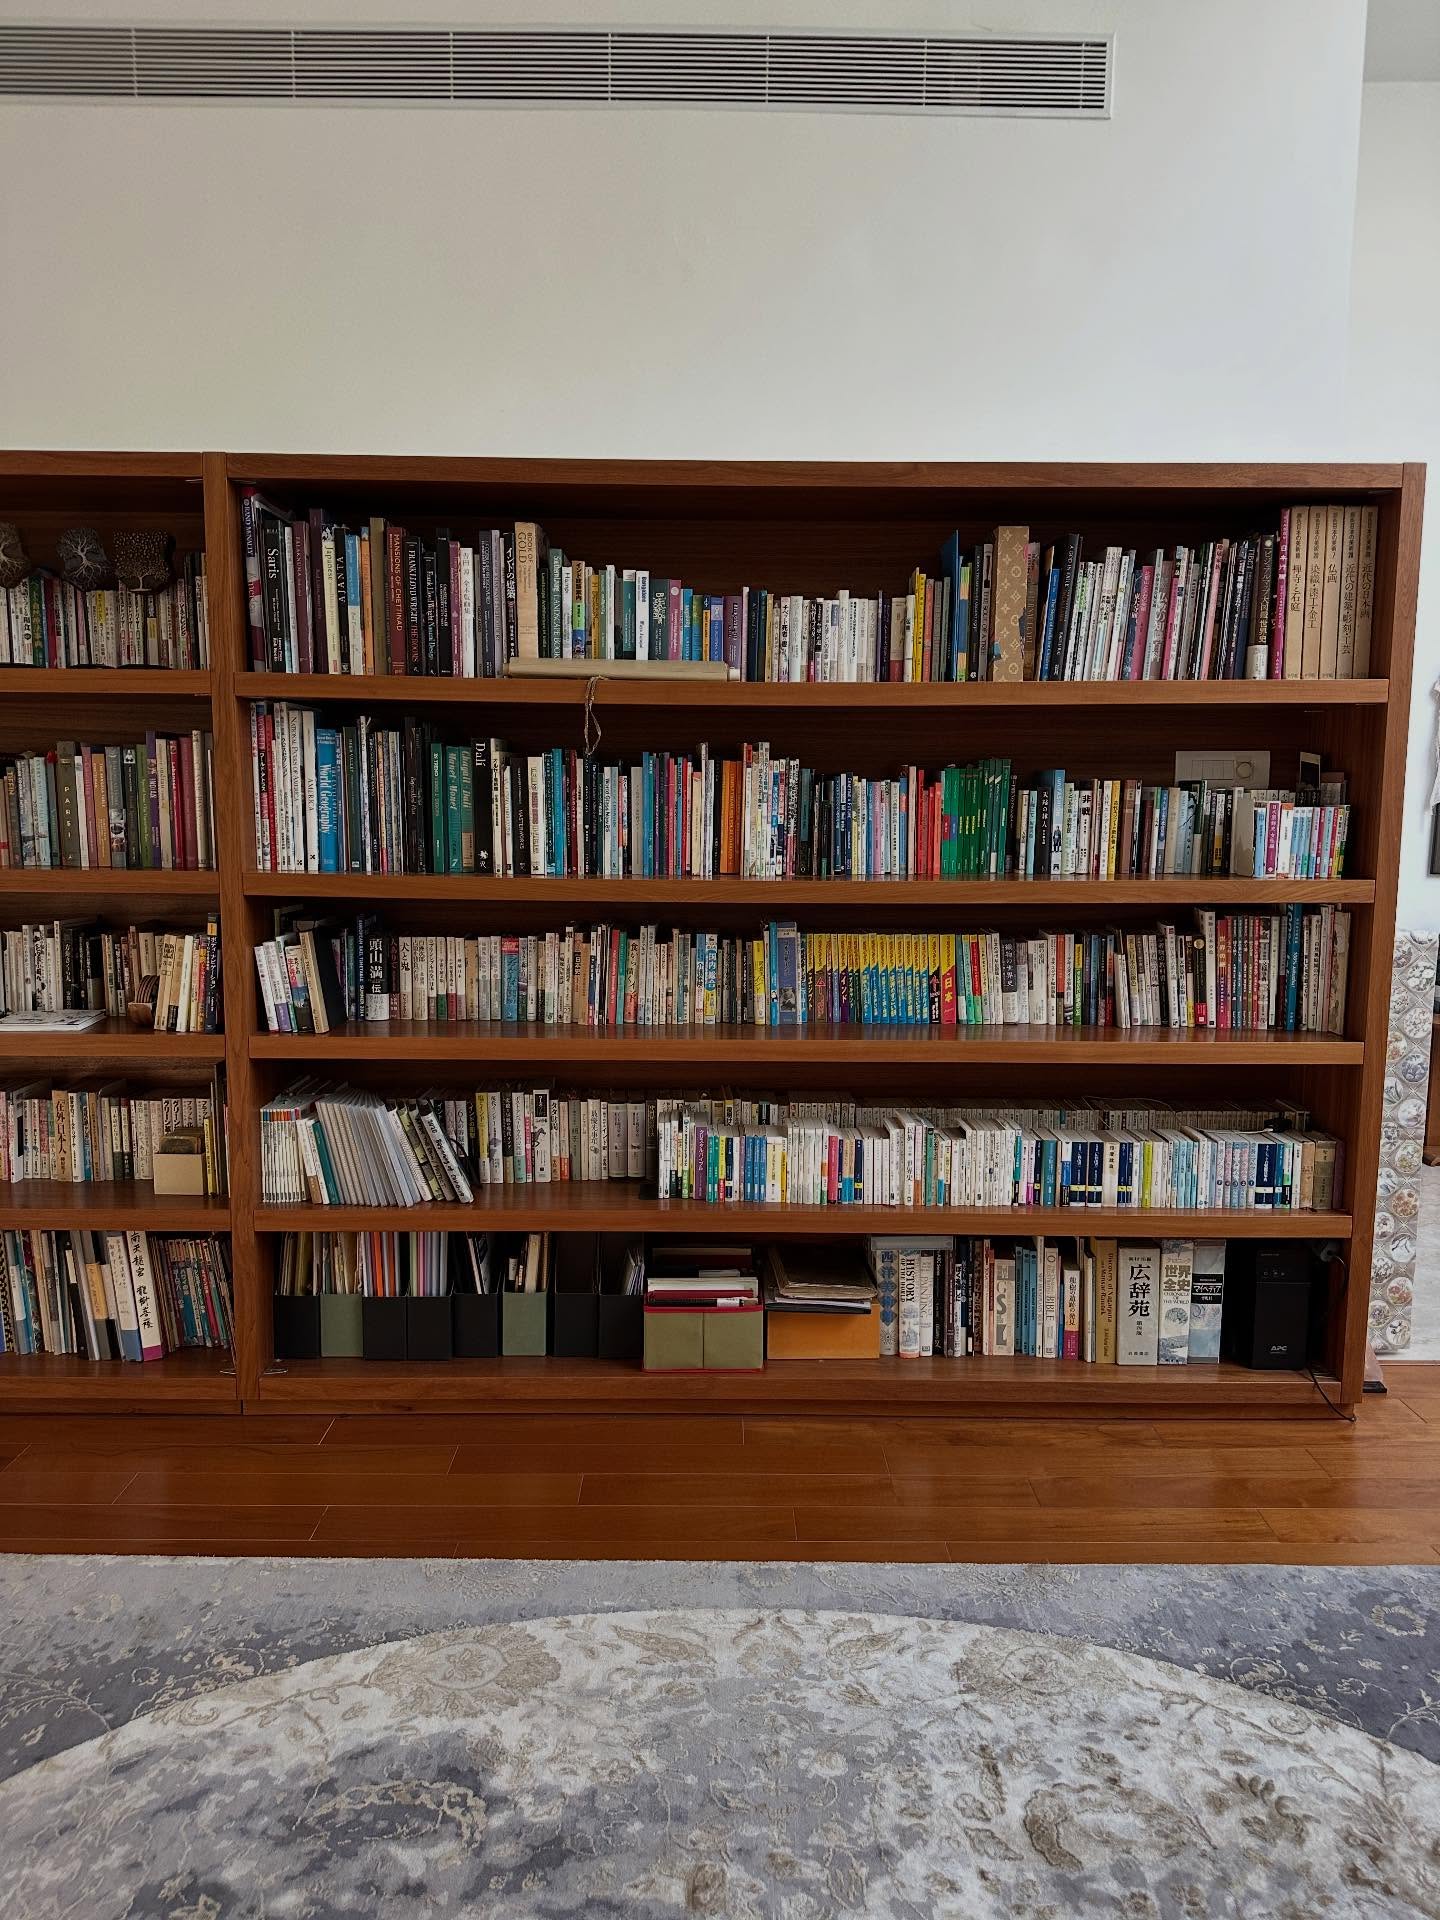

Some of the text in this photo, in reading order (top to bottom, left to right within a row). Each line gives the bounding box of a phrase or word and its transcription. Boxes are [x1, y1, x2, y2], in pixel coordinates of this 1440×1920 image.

[518, 531, 527, 563] GOLD
[267, 548, 280, 579] Saris
[325, 546, 334, 581] Japanese
[337, 556, 346, 603] AJANTA
[1327, 564, 1338, 584] 仏画
[1360, 564, 1374, 619] 近代の日本画
[554, 594, 562, 636] LANDSCAPE
[1341, 564, 1355, 655] 近代の建築・彫刻・工芸
[1258, 616, 1268, 644] 世界史
[461, 752, 471, 784] Chagall
[476, 742, 486, 767] Dalí
[8, 771, 17, 796] TIFFIN
[150, 778, 158, 799] INDIAN
[448, 752, 458, 810] Manet Monet
[64, 786, 72, 839] PARSI
[320, 764, 332, 834] World Geography
[1082, 794, 1092, 816] 非戦
[369, 938, 383, 994] 頭山満伝
[400, 942, 411, 972] 犬と鬼
[840, 975, 848, 1004] インド
[944, 976, 953, 1003] 日本
[55, 1101, 66, 1154] 在外日本人
[906, 1258, 915, 1303] HISTORY
[1162, 1278, 1191, 1292] 全史
[1164, 1264, 1192, 1279] 世界
[920, 1276, 928, 1319] PAINTING
[1128, 1264, 1152, 1318] 広辞苑
[1192, 1284, 1222, 1294] マイペディア
